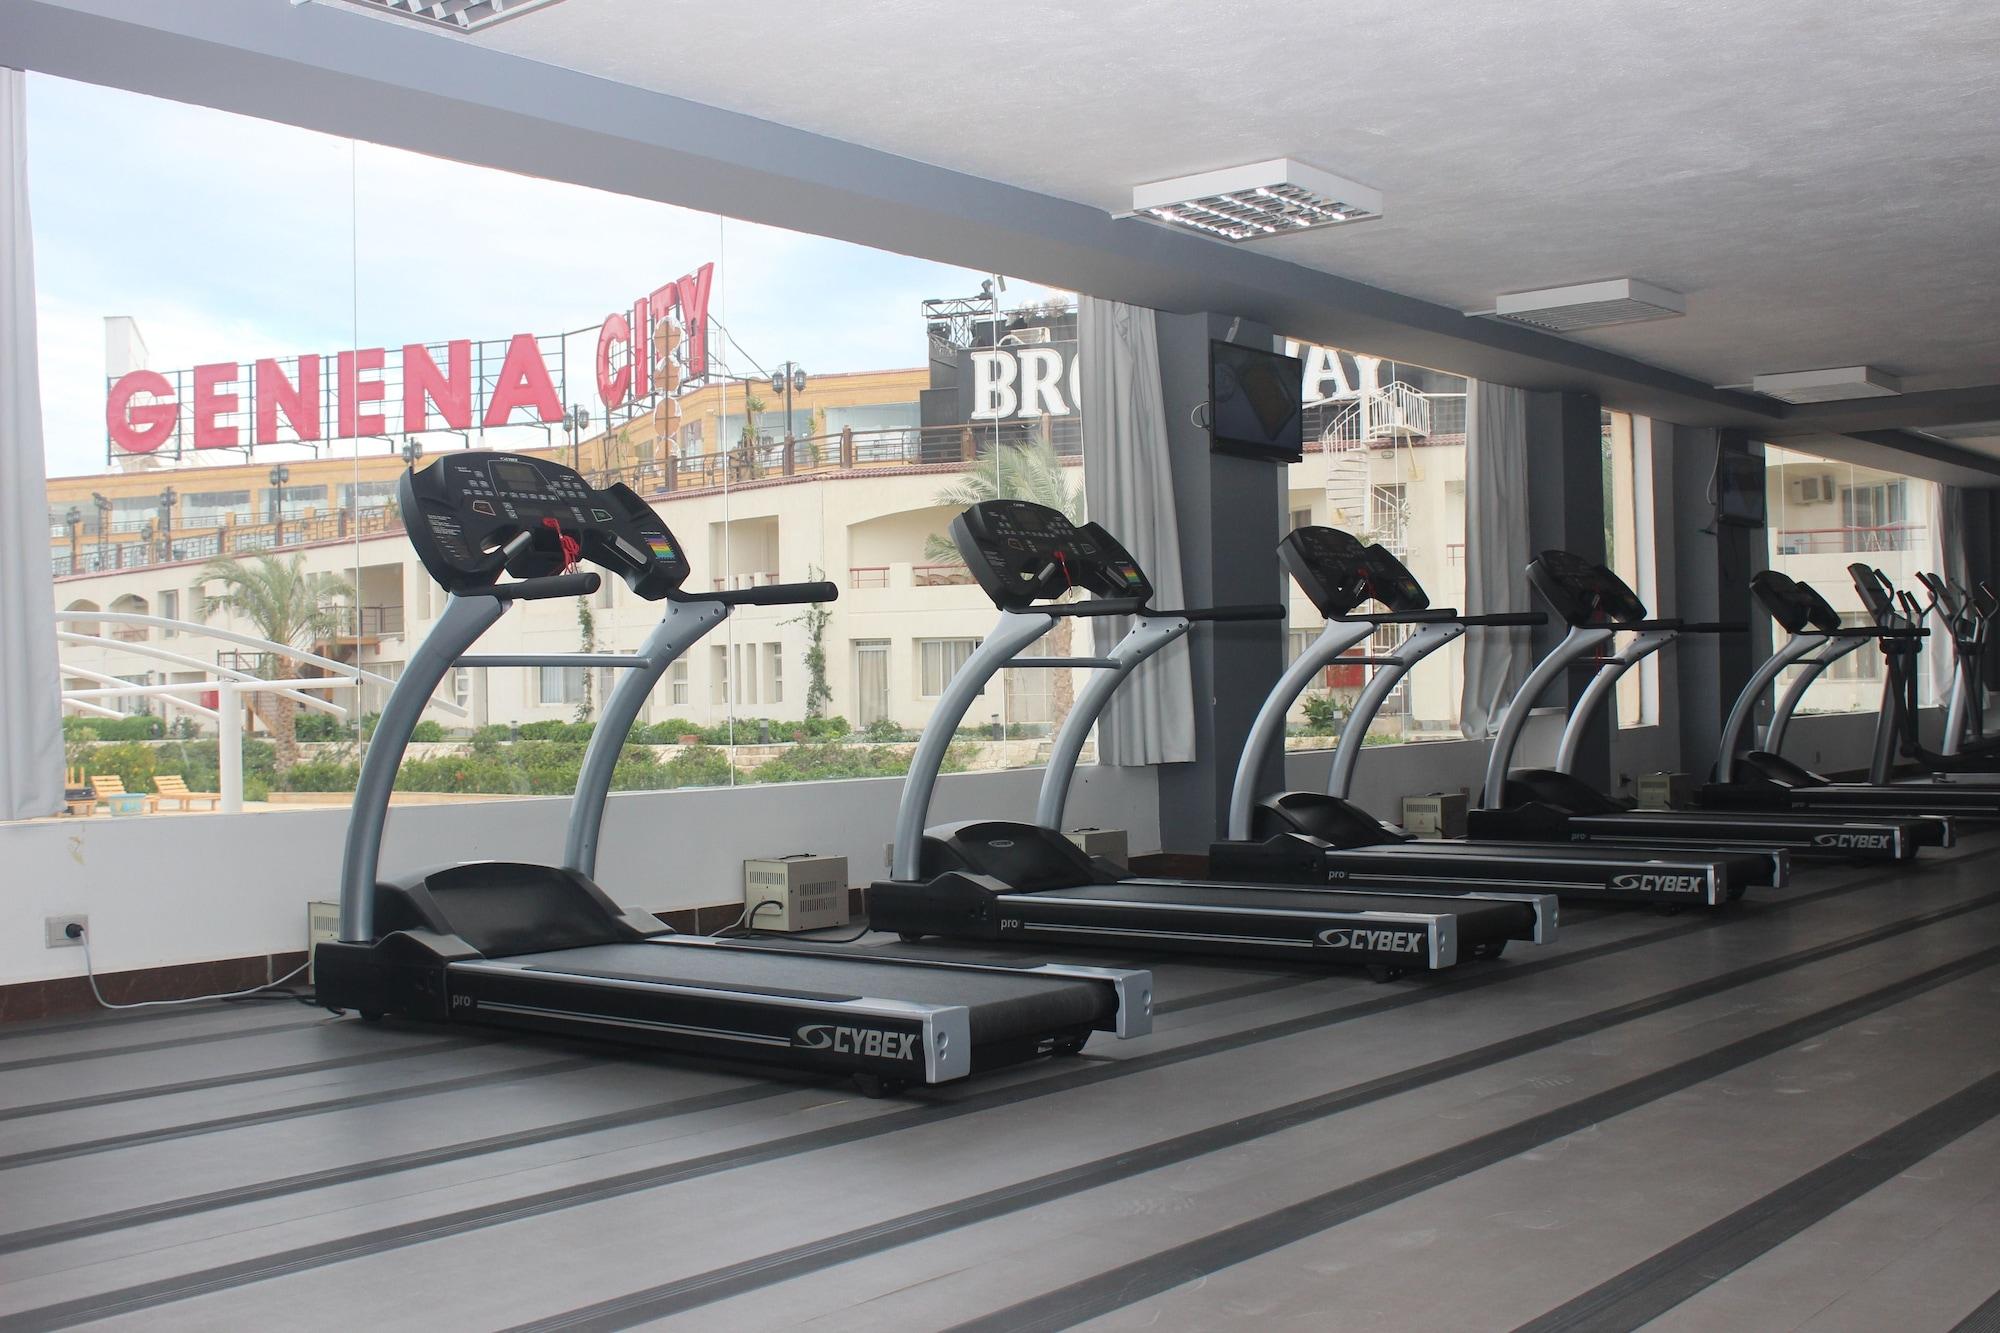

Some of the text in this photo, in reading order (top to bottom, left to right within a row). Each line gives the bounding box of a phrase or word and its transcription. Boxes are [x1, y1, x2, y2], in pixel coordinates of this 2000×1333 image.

[105, 262, 714, 453] GENENA CITY
[970, 347, 1081, 420] BR
[1285, 338, 1382, 403] AY
[1837, 834, 1890, 849] CYBEX
[1328, 870, 1703, 893] pro CYBEX
[1000, 919, 1422, 953] pro CYBEX
[452, 994, 917, 1061] pro CYBEX
